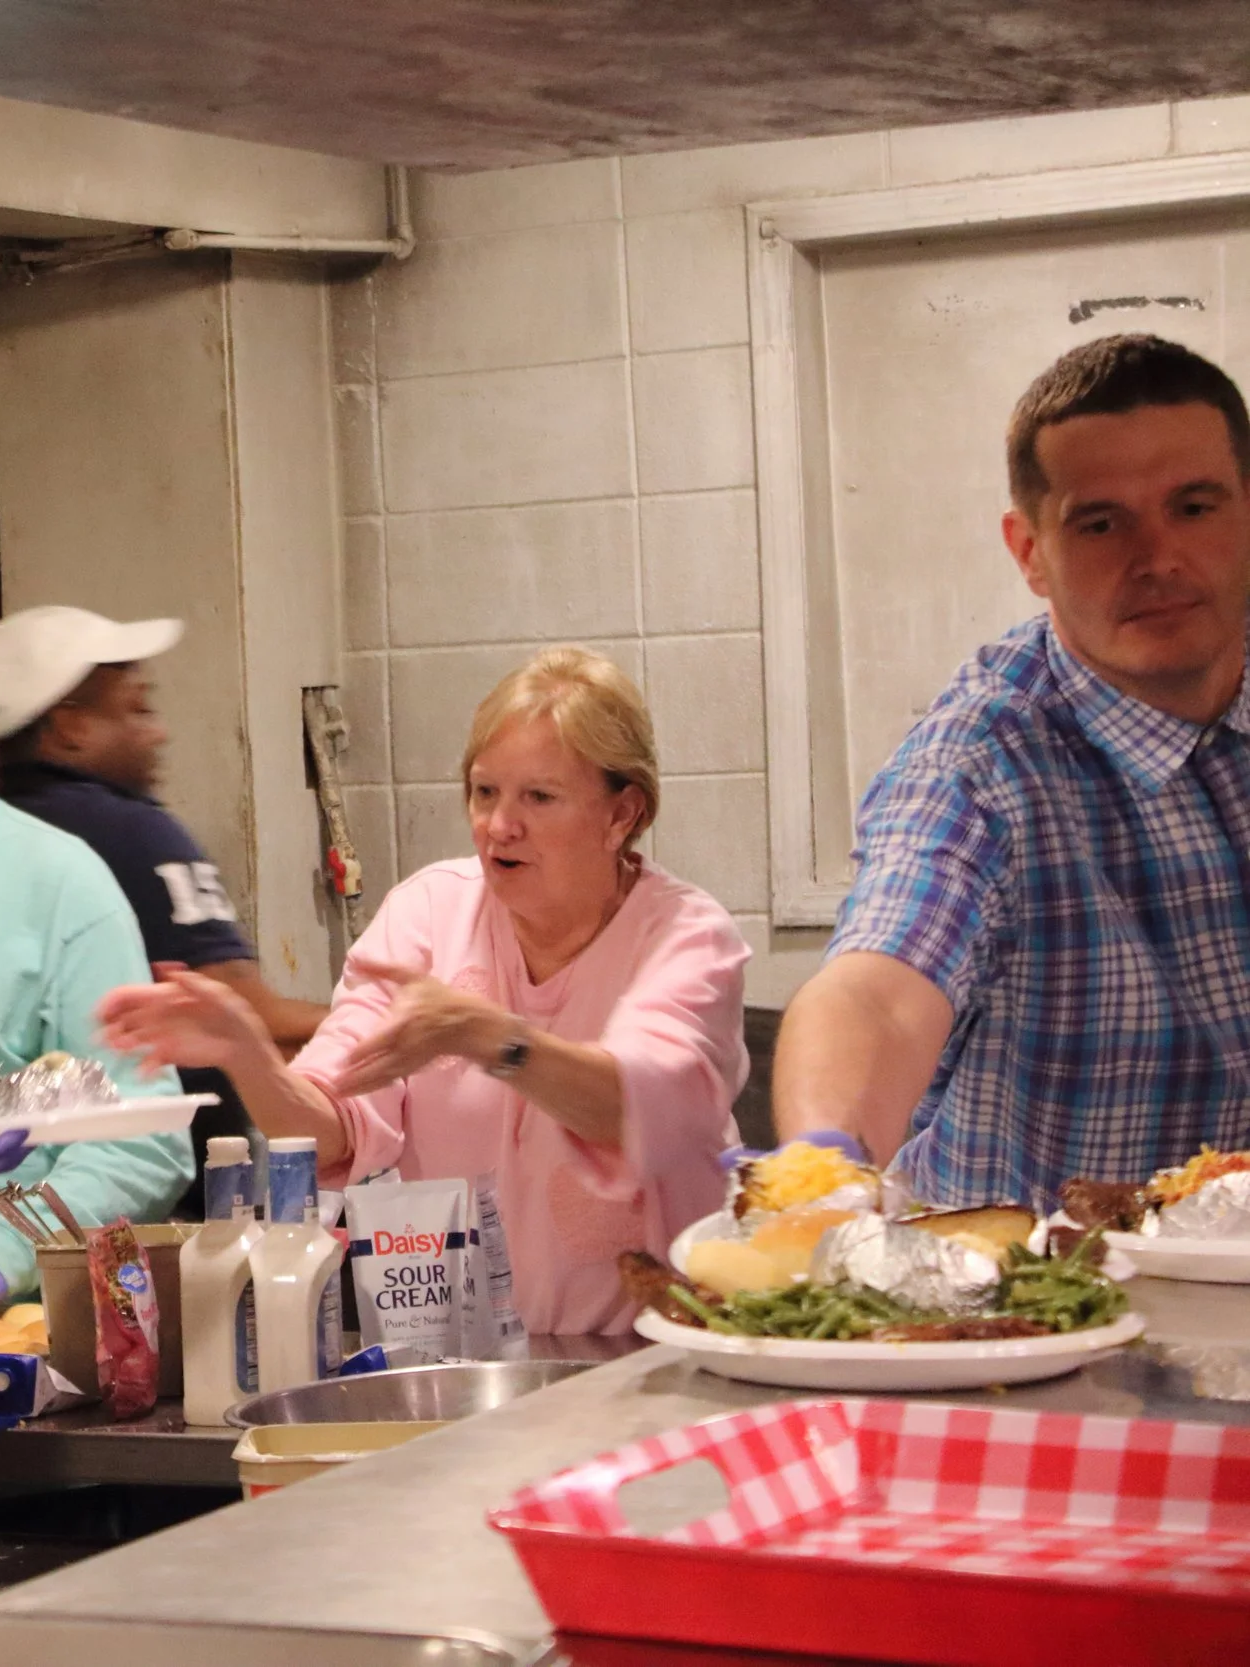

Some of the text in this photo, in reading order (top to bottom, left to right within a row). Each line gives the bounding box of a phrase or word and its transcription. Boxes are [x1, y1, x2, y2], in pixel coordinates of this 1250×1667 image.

[373, 1230, 445, 1259] Daisy
[383, 1264, 446, 1288] SOUR
[375, 1285, 452, 1310] CREAM
[384, 1318, 407, 1329] Pure
